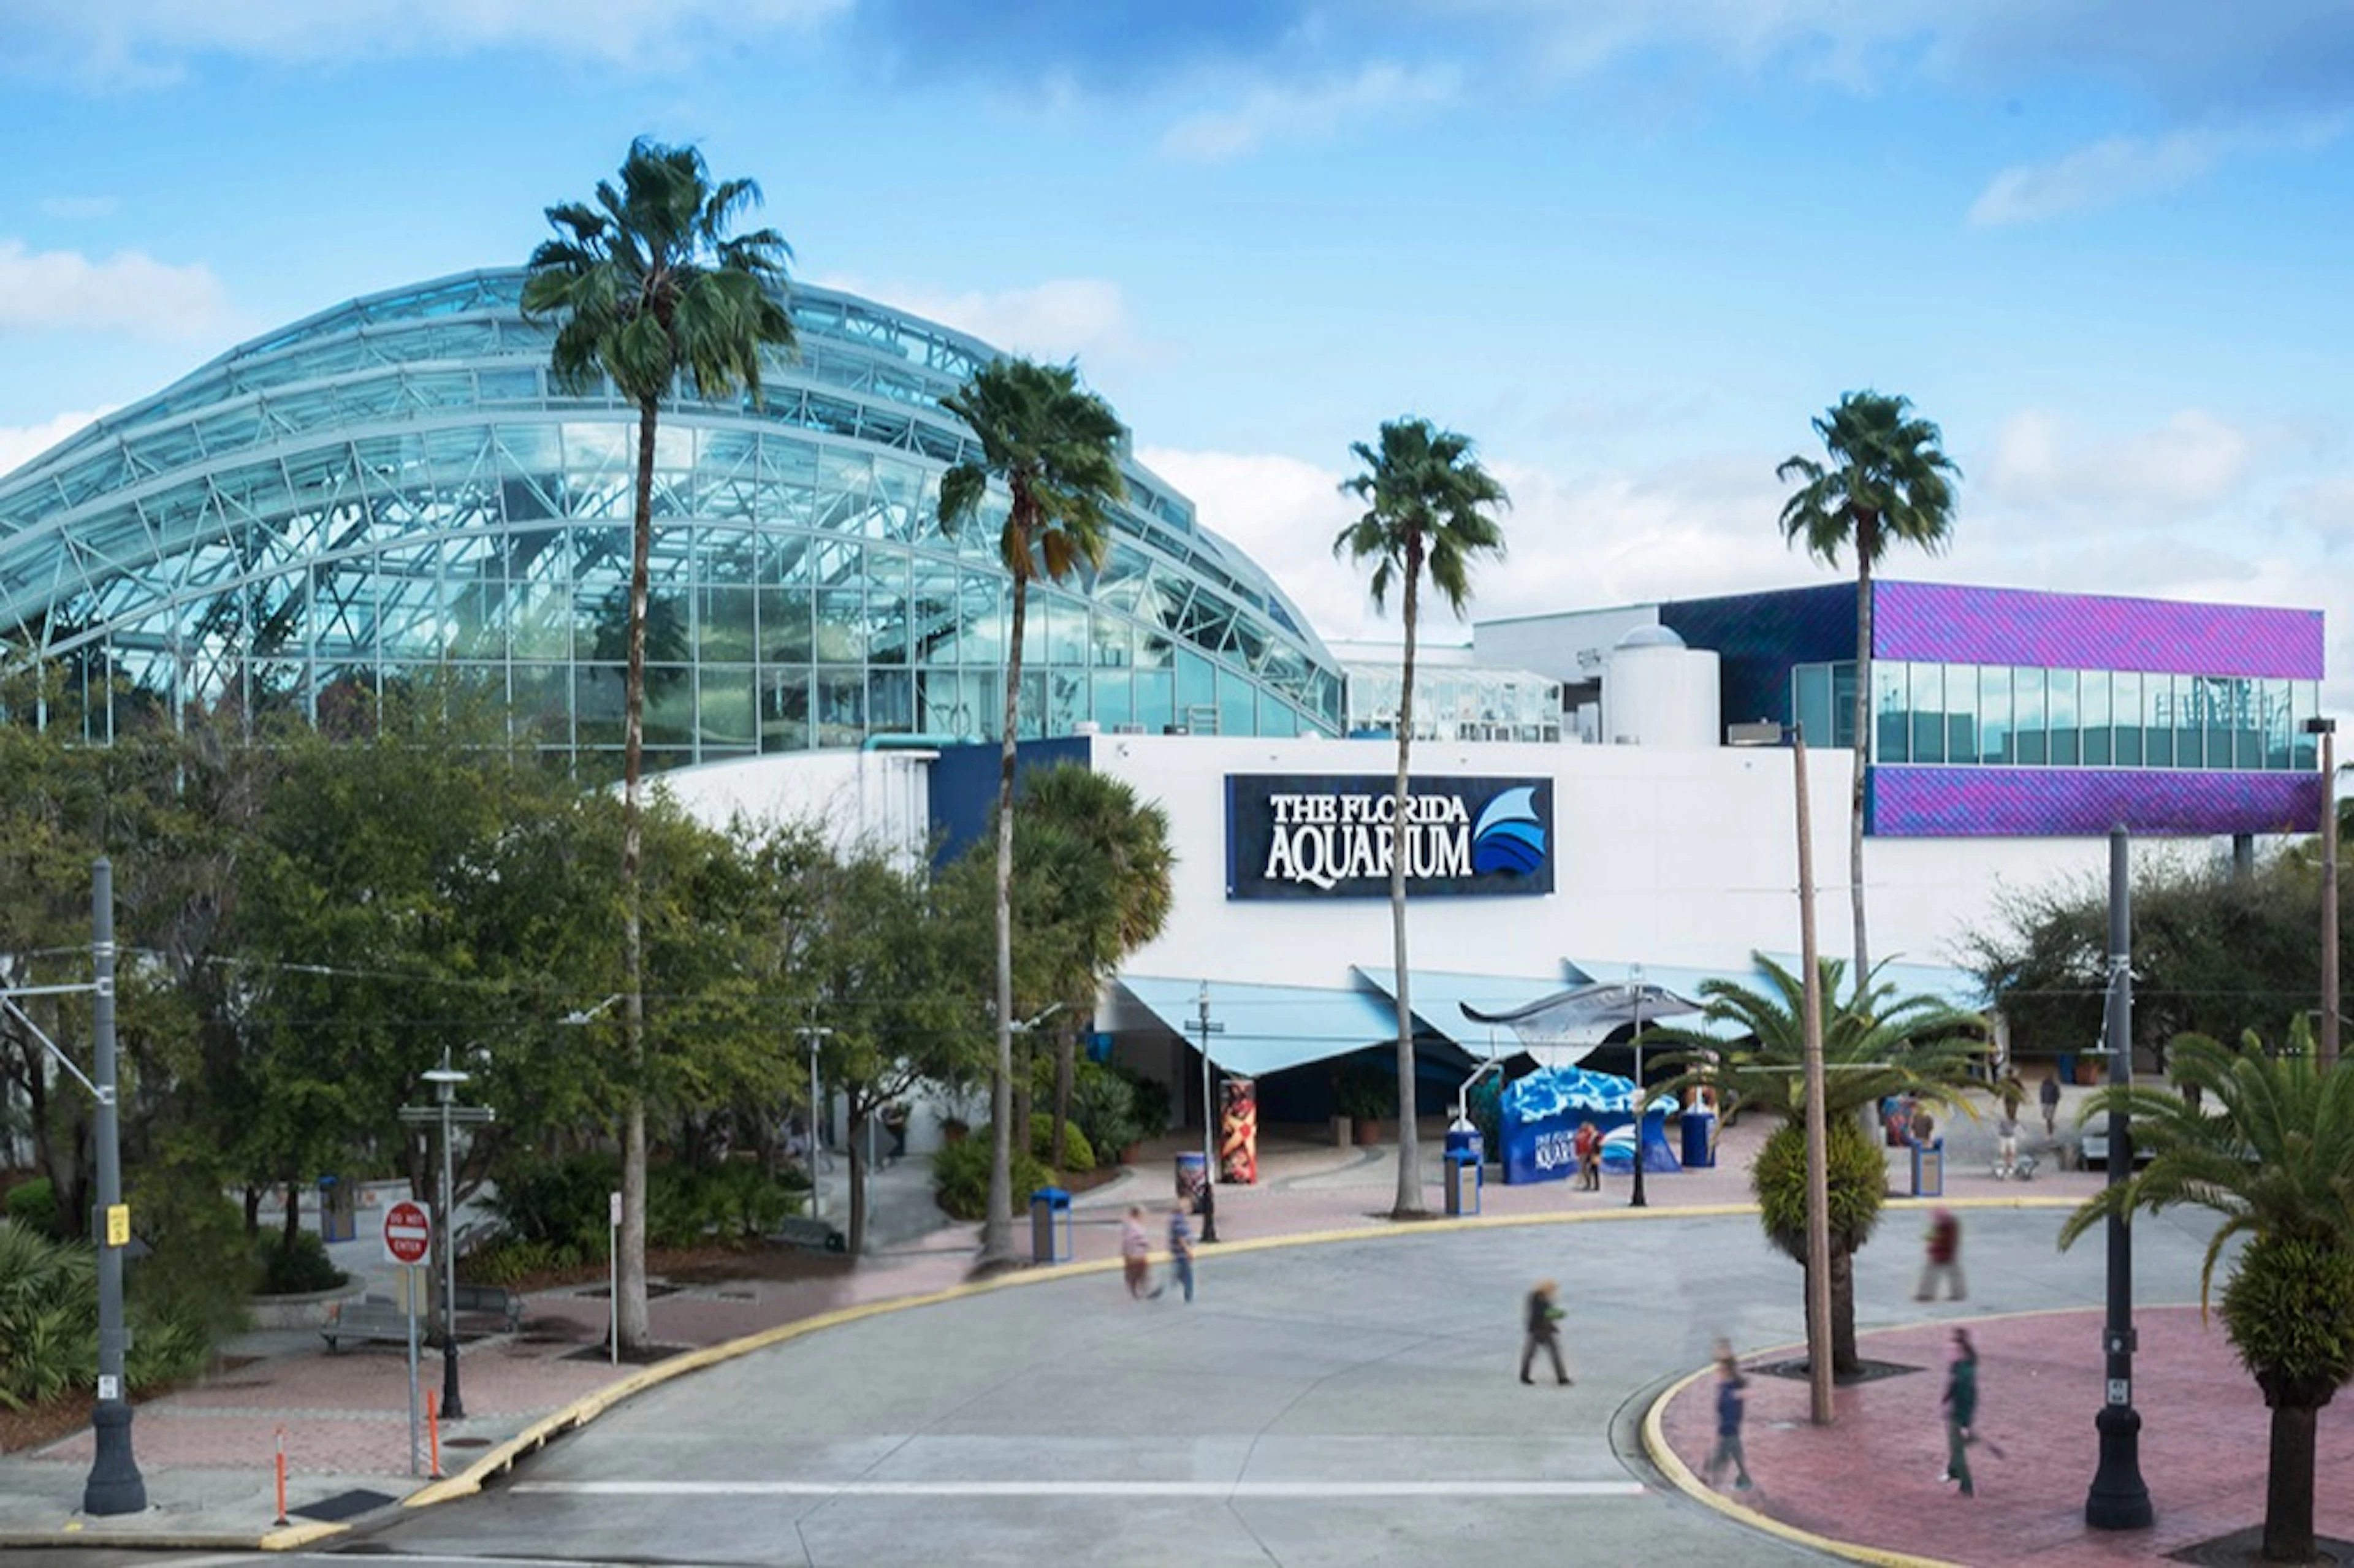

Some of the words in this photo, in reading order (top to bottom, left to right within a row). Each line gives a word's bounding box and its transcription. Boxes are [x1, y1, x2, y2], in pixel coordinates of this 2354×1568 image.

[1270, 794, 1337, 823] THE
[1265, 824, 1472, 889] AQUARIUM
[390, 1214, 403, 1224] DO
[406, 1214, 424, 1225] NOT
[394, 1240, 422, 1252] ENTER
